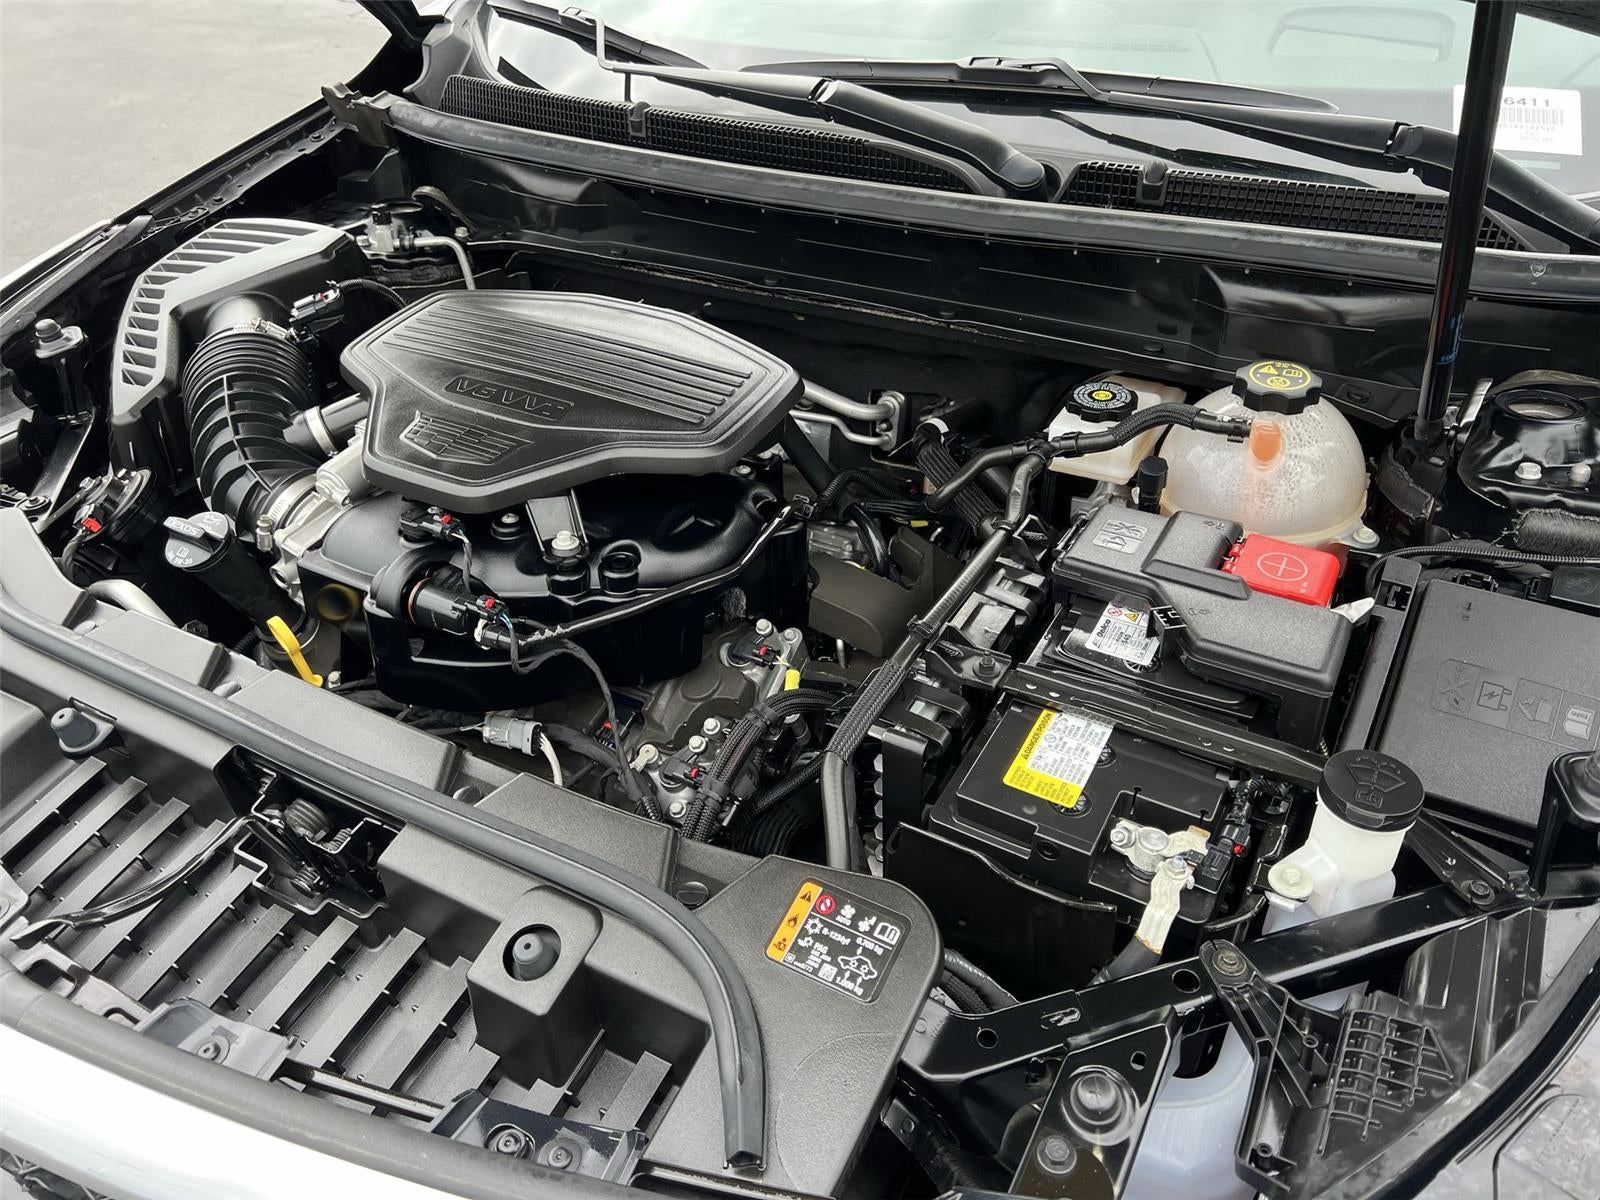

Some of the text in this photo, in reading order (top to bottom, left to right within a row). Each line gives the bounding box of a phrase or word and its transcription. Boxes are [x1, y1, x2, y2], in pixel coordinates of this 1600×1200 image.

[835, 915, 851, 926] AUTO
[813, 942, 829, 954] PAG
[874, 944, 883, 955] kg
